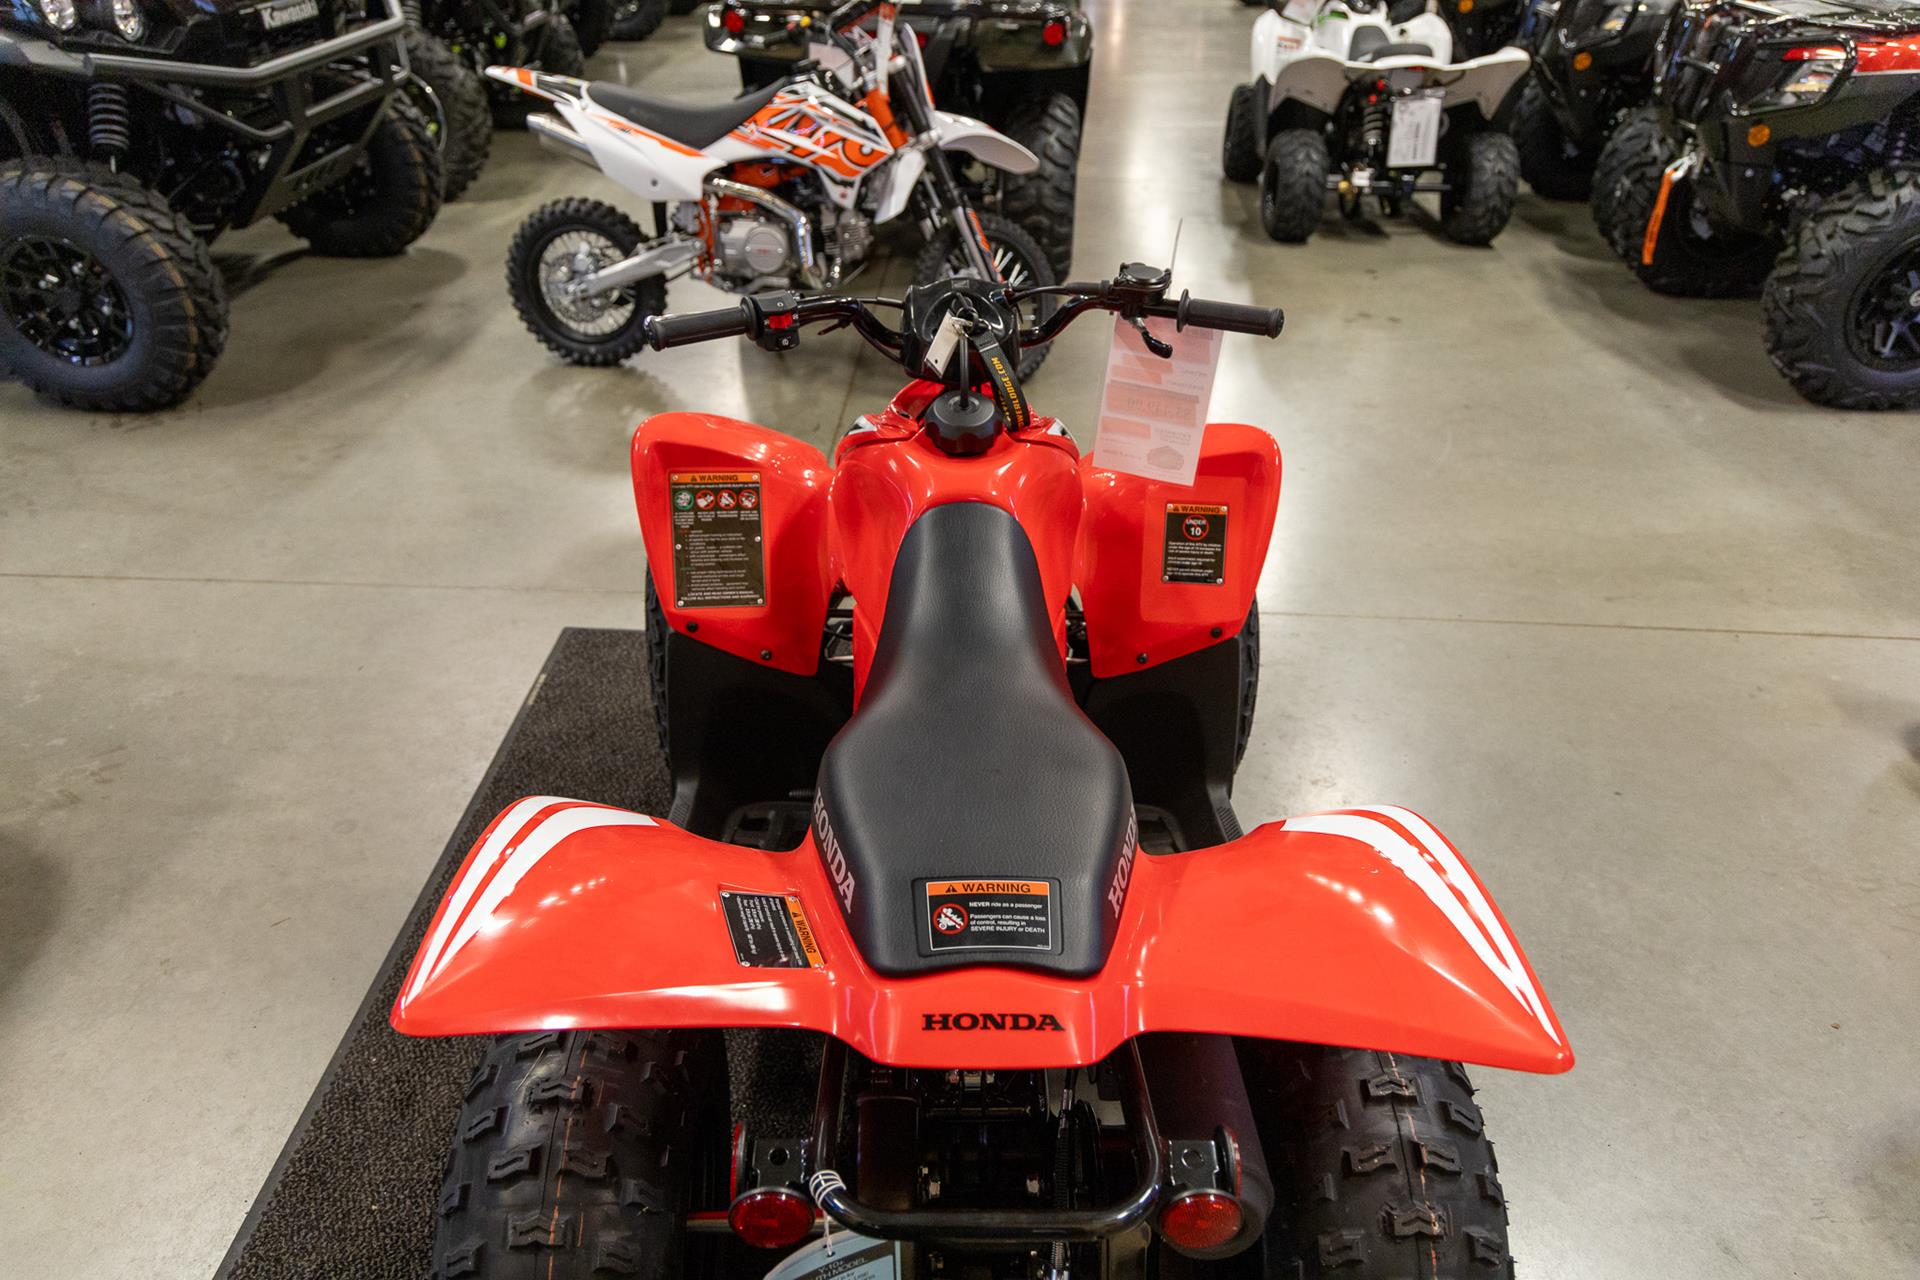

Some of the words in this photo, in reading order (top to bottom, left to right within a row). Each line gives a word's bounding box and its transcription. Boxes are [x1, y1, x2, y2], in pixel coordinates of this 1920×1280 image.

[698, 474, 739, 482] WARNING
[1180, 505, 1220, 514] WARNING
[1190, 527, 1202, 536] 10
[814, 787, 855, 914] HONDA
[961, 883, 1031, 893] WARNING
[796, 919, 817, 954] WARNING
[921, 1013, 1066, 1031] HONDA
